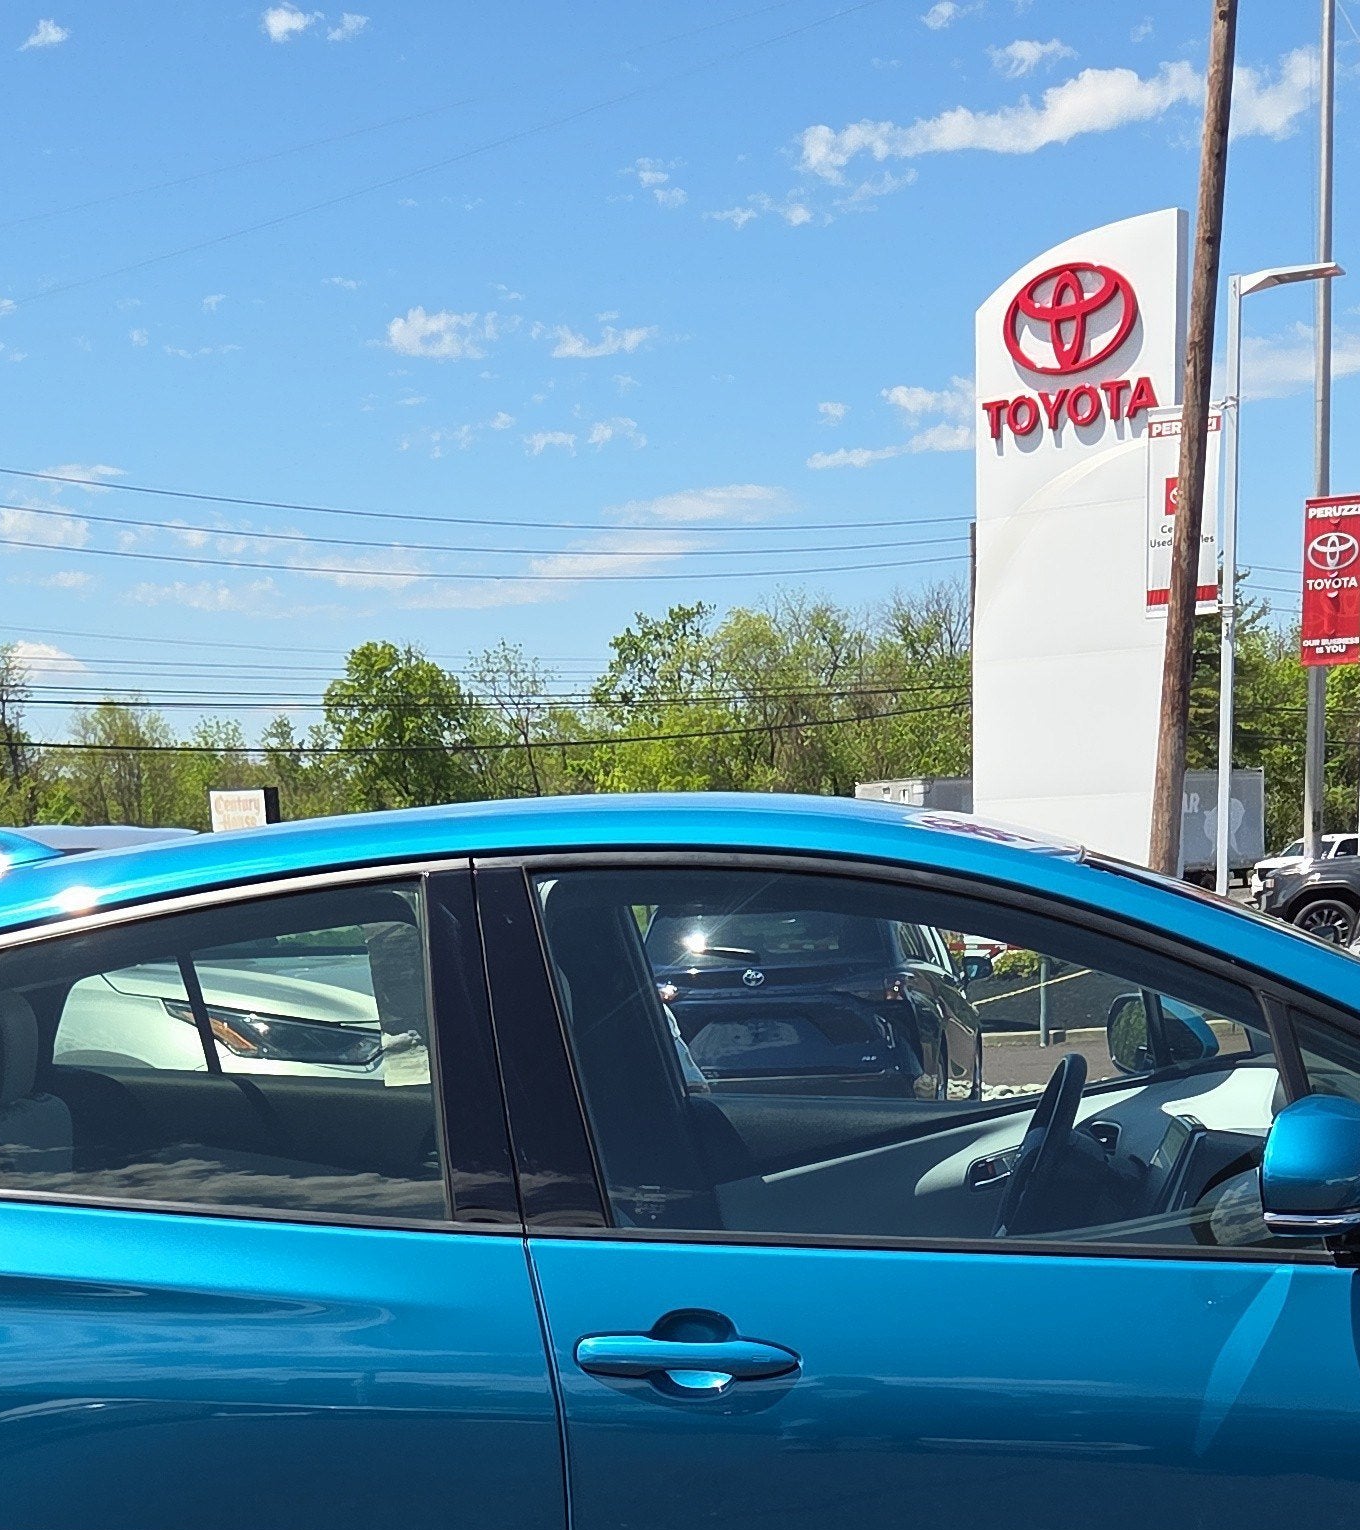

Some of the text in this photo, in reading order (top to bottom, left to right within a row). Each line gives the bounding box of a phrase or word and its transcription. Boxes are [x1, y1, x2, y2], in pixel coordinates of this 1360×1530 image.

[982, 376, 1159, 440] TOYOTA
[1150, 537, 1173, 548] Used
[1306, 576, 1359, 591] TOYOTA
[1325, 644, 1347, 654] YOU
